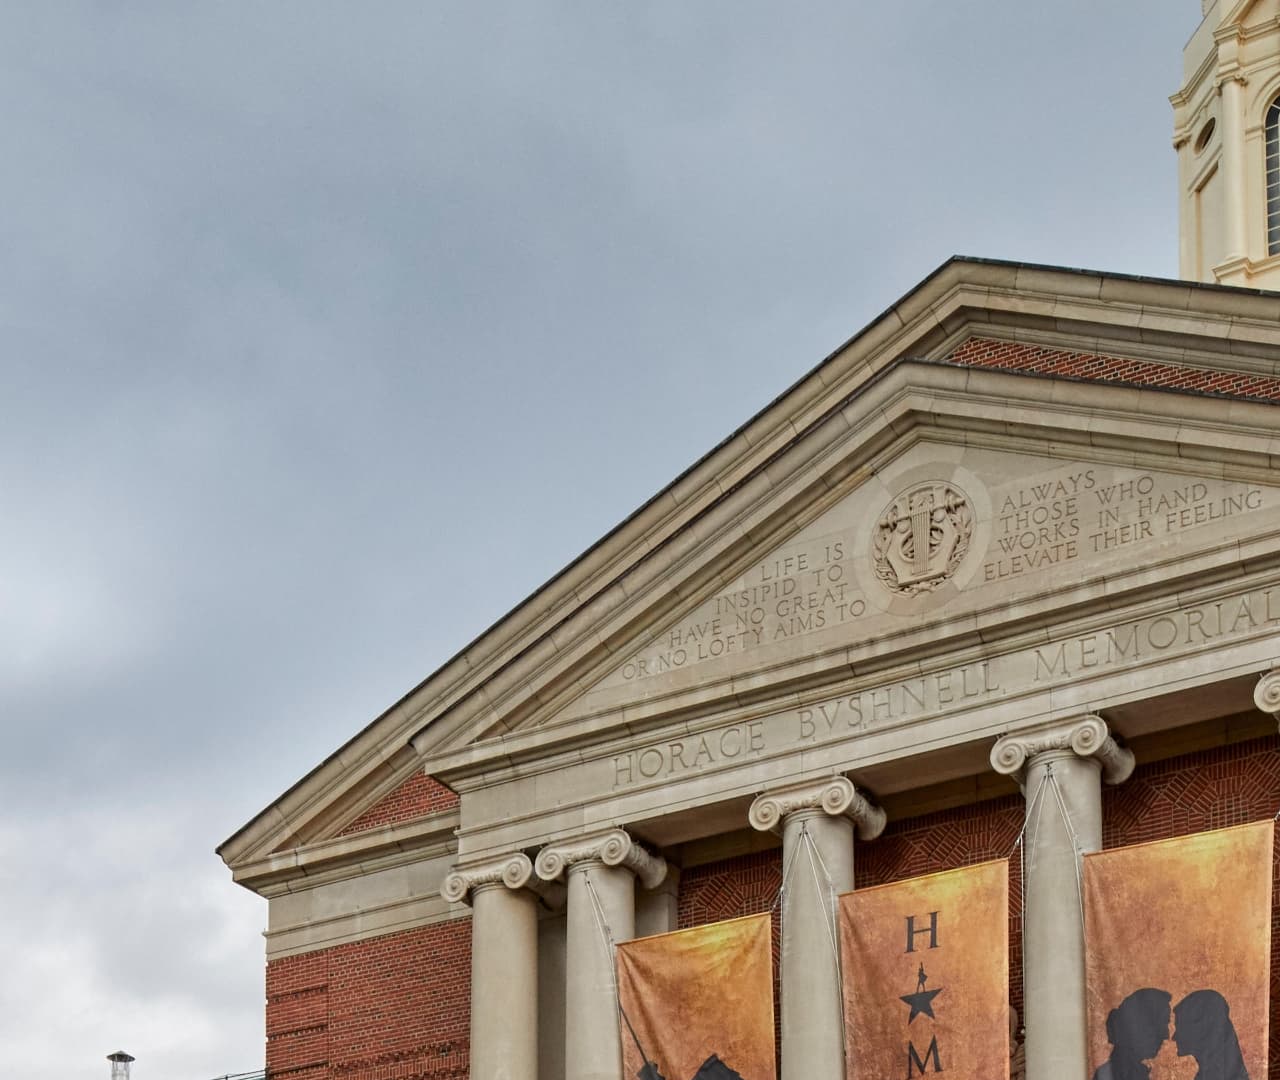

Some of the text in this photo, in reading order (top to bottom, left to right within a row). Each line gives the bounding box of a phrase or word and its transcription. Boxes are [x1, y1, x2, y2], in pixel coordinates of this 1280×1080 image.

[997, 483, 1208, 554] WORKS IN HAND
[1000, 470, 1096, 514] ALWAYS
[1000, 476, 1155, 534] THOSE WHO
[760, 543, 844, 582] LIFE IS
[984, 490, 1262, 582] ELEVATE THEIR FEELING
[670, 583, 849, 648] HAVE NO GREAT
[716, 564, 843, 615] INSIPID TO
[622, 599, 866, 680] OR NO LOFTY AIMS TO
[612, 720, 766, 787] HORACE
